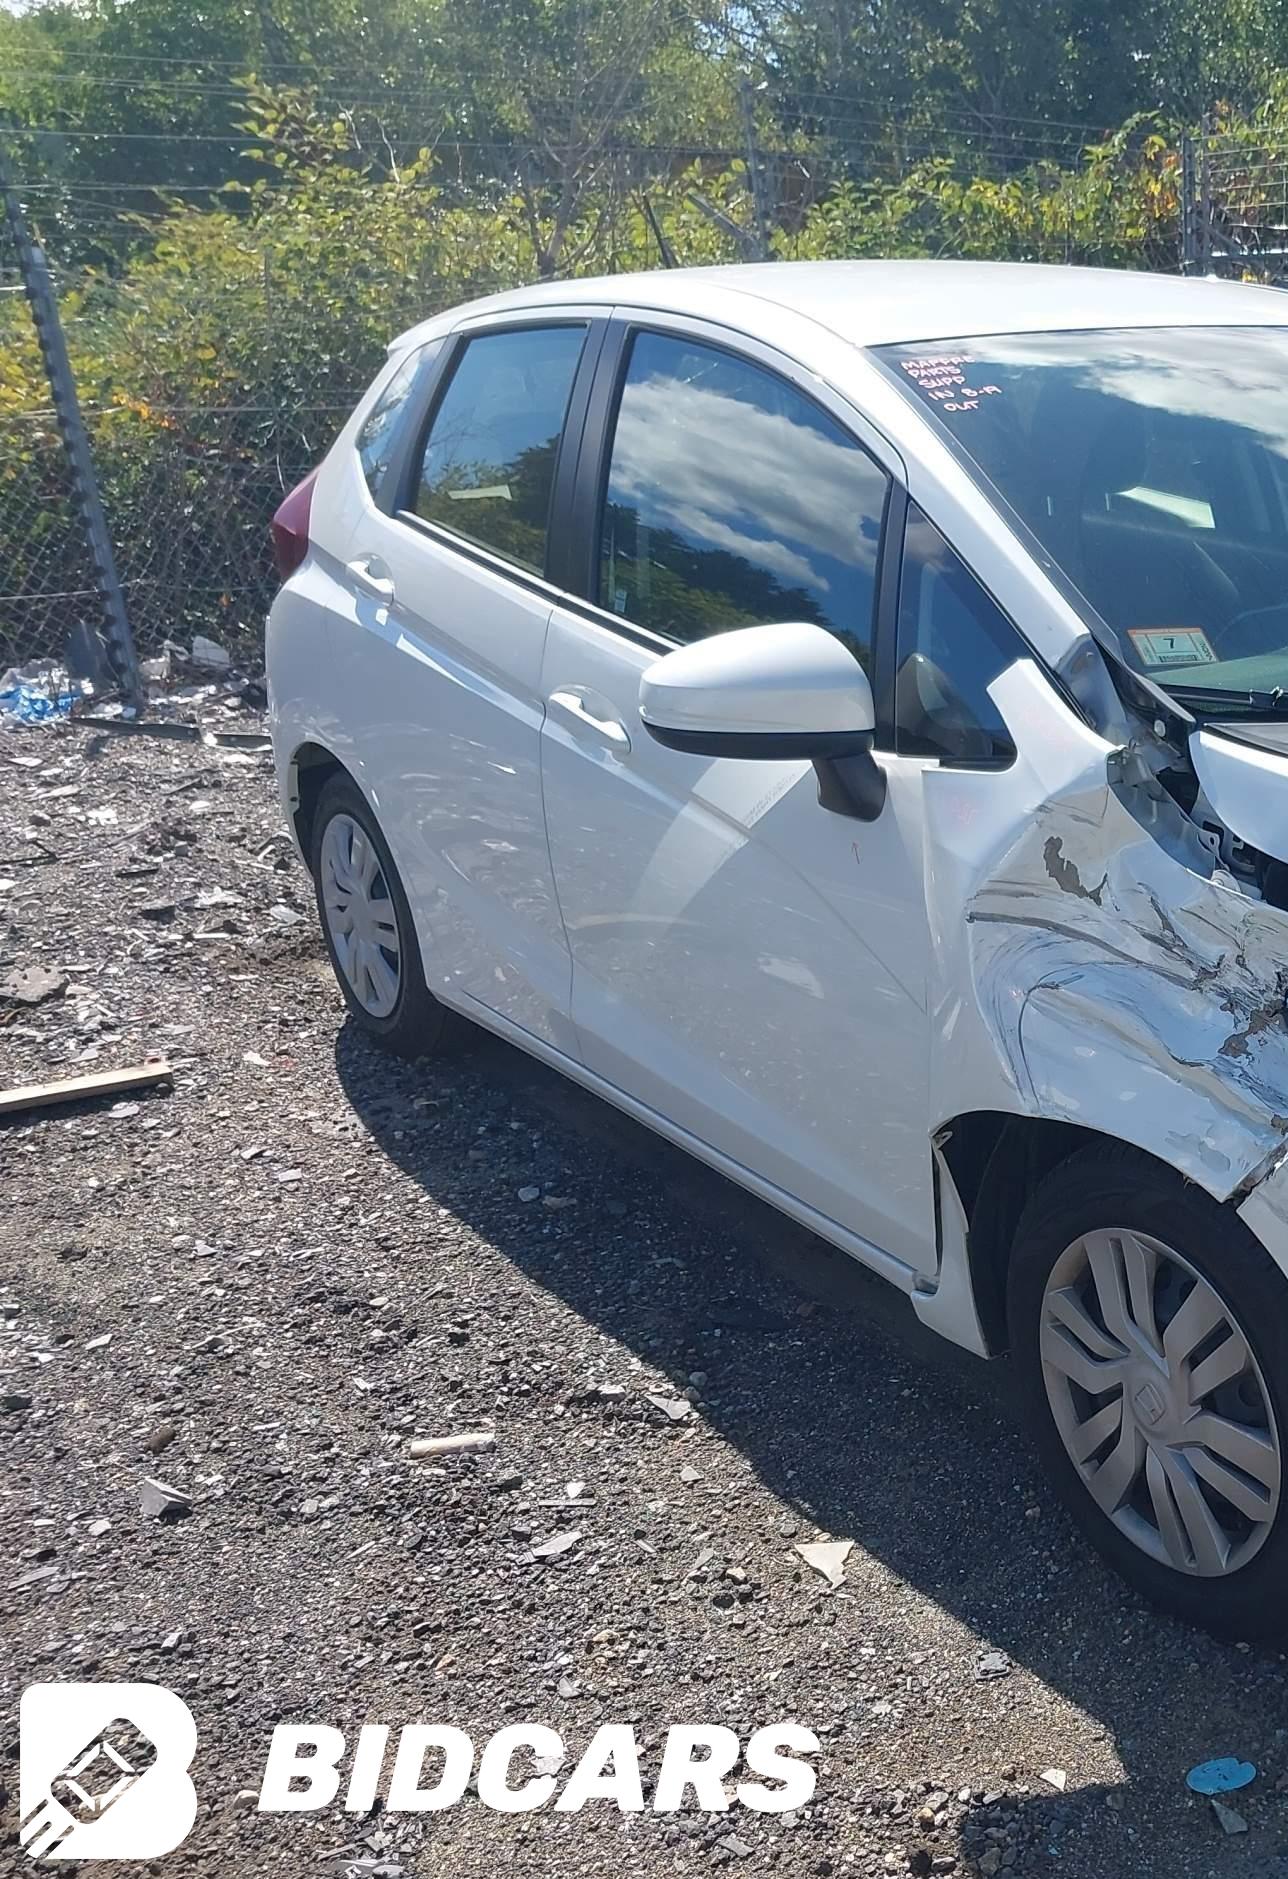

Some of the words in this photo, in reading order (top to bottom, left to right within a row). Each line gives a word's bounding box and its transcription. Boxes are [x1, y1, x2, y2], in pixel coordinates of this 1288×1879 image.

[908, 366, 961, 379] PARTS
[918, 376, 966, 389] SUPP
[928, 390, 955, 401] IN
[943, 400, 980, 412] OUT
[1163, 637, 1175, 649] 7
